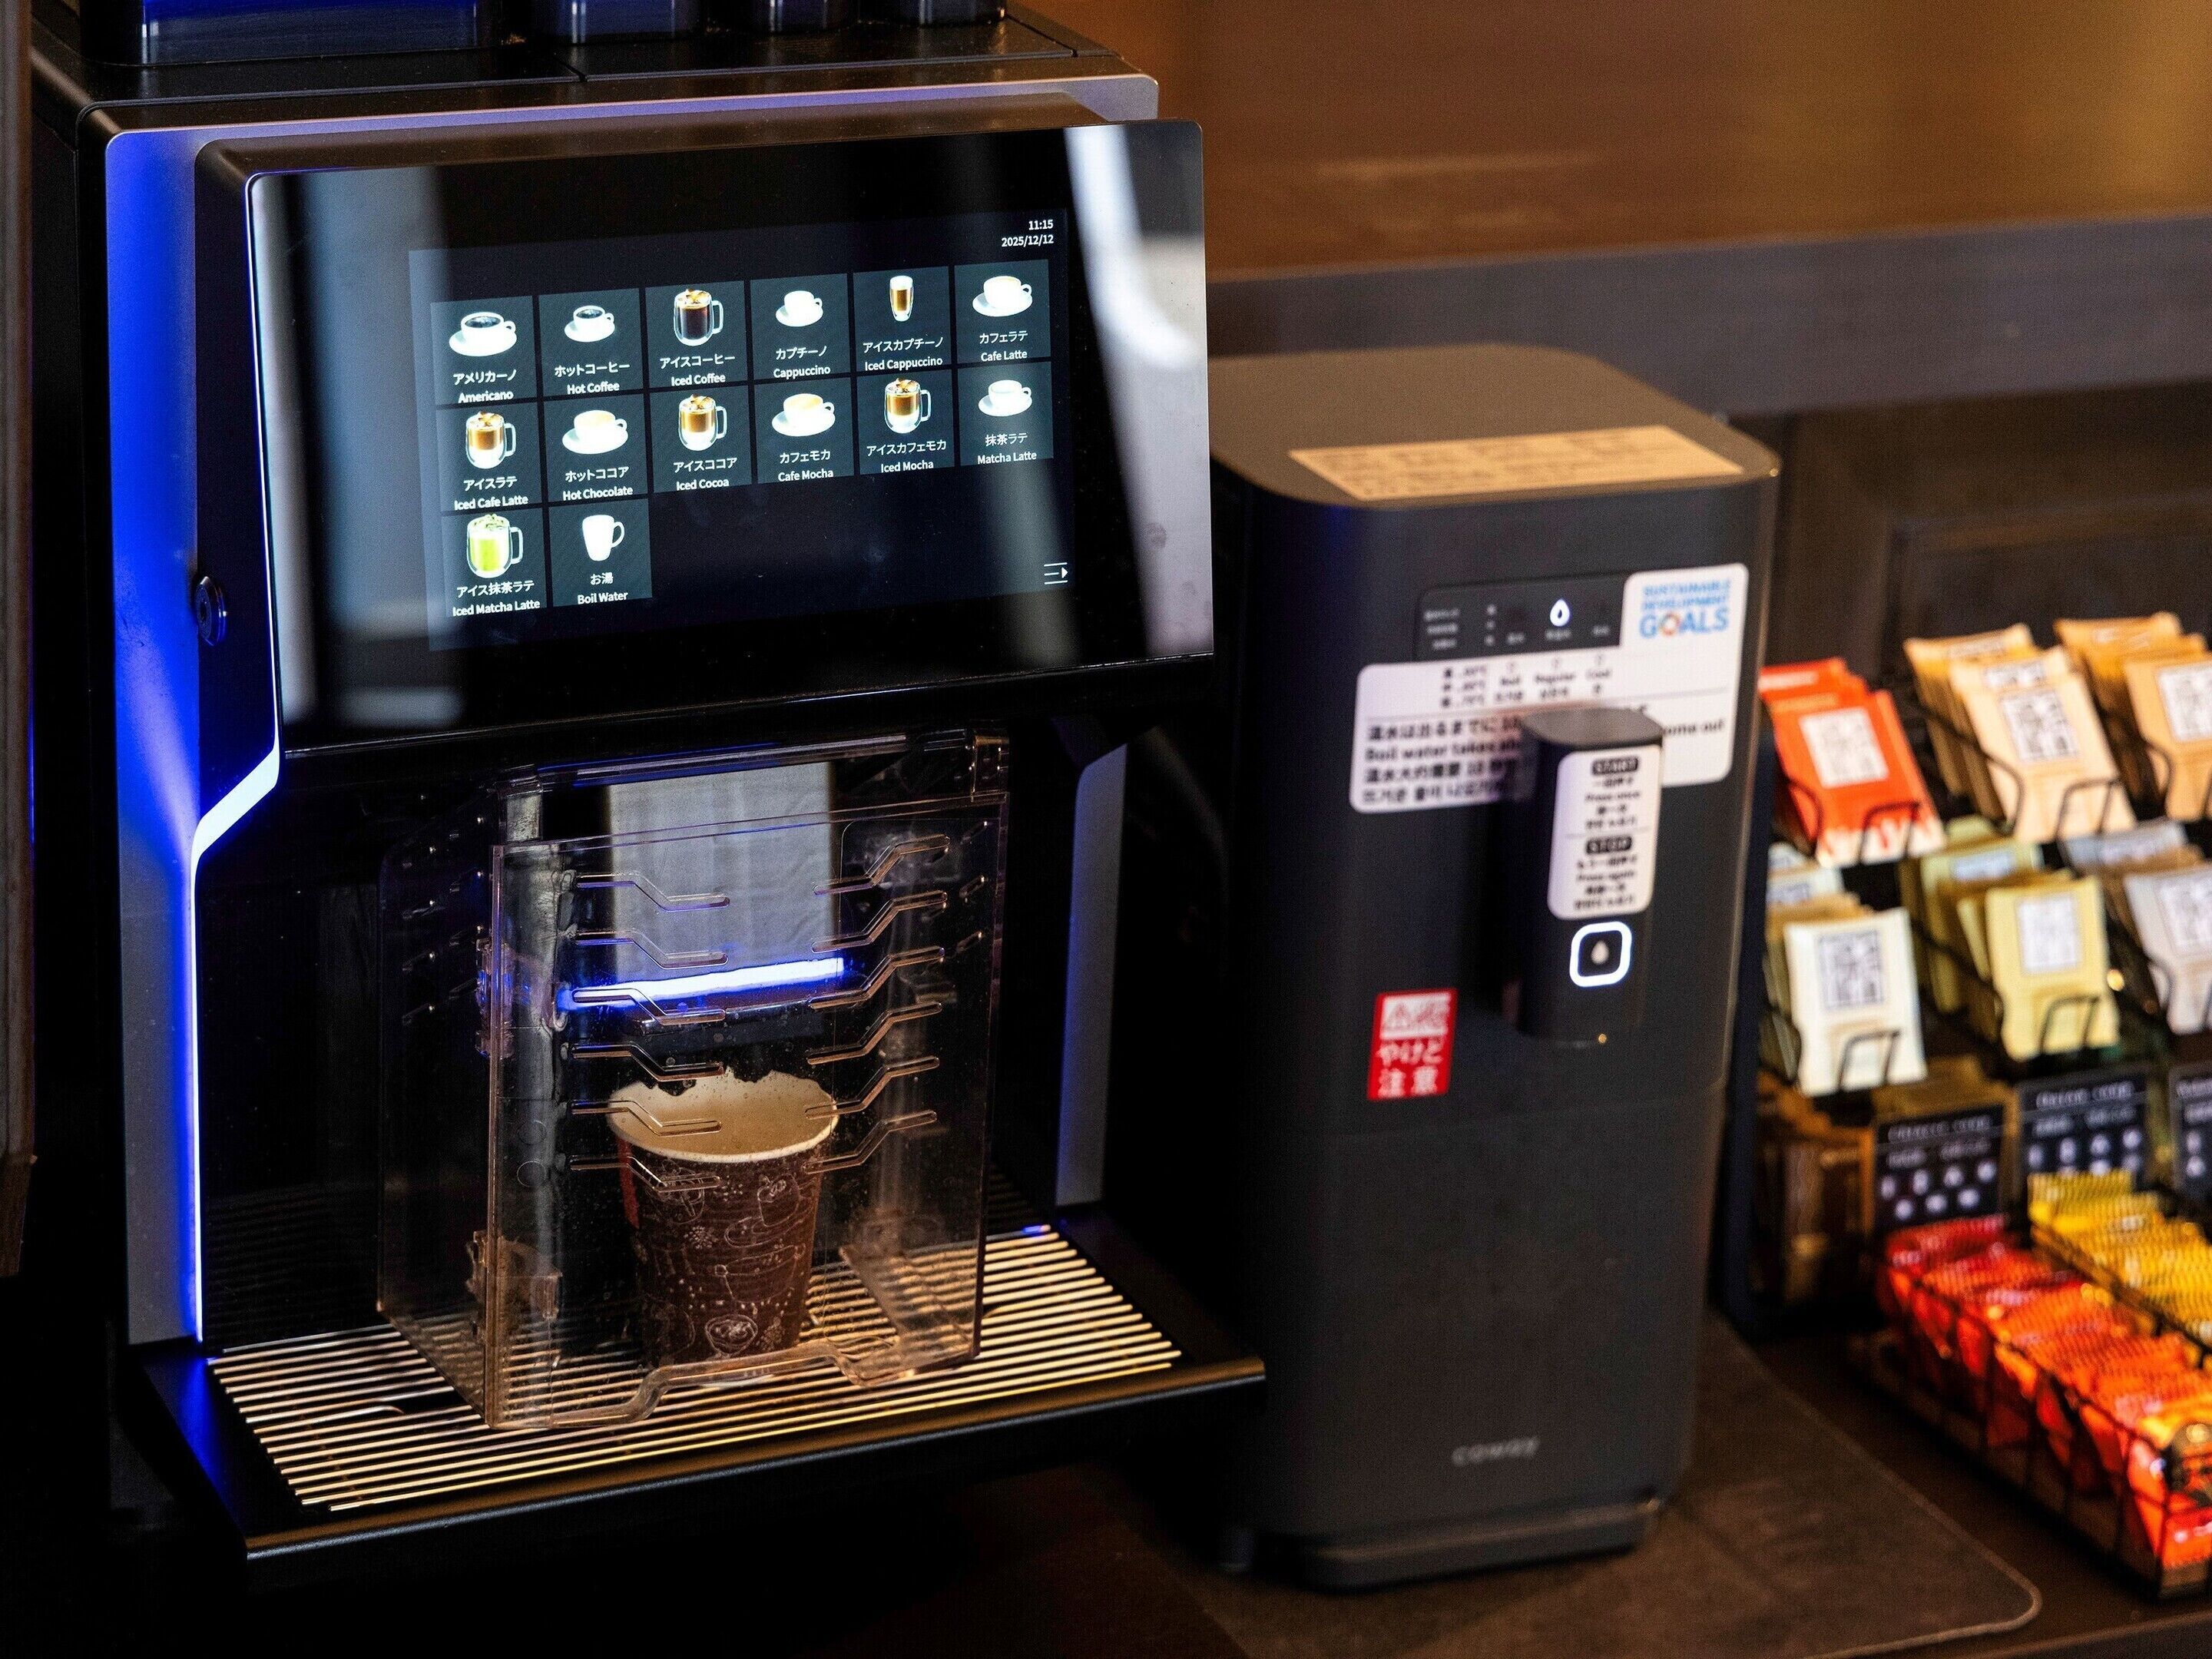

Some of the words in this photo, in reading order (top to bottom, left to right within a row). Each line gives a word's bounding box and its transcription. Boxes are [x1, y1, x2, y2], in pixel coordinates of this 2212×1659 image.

[1028, 220, 1054, 230] 11:15
[1001, 234, 1054, 247] 2025/12/12
[863, 336, 944, 354] アイスカプチーノ
[979, 330, 1028, 345] カフェラテ
[775, 346, 828, 360] カプチーノ
[980, 351, 1002, 363] Cafe
[1002, 349, 1028, 360] Latte
[660, 354, 737, 369] アイスコーヒー
[864, 359, 885, 372] Iced
[886, 356, 943, 372] Cappuccino
[452, 369, 517, 385] アメリカーノ
[554, 362, 631, 378] ホットコーヒー
[773, 364, 831, 381] Cappuccino
[671, 375, 691, 386] Iced
[693, 373, 727, 385] Coffee
[567, 384, 586, 395] Hot
[587, 382, 620, 393] Coffee
[458, 389, 514, 404] Americano
[985, 432, 1028, 446] 抹茶ラテ
[866, 439, 947, 457] アイスカフェモカ
[779, 449, 831, 464] カフェモカ
[977, 451, 1012, 465] Matcha
[1012, 449, 1038, 462] Latte
[674, 458, 737, 474] アイスココア
[880, 462, 900, 474] Iced
[902, 459, 934, 472] Mocha
[565, 467, 630, 483] ホットココア
[777, 472, 800, 482] Cafe
[801, 467, 834, 480] Mocha
[463, 475, 518, 492] アイスラテ
[676, 478, 697, 491] Iced
[698, 477, 730, 489] Cocoa
[563, 490, 581, 501] Hot
[582, 485, 634, 499] Chocolate
[454, 498, 475, 511] Iced
[477, 496, 501, 508] Cafe
[502, 494, 528, 506] Latte
[590, 572, 614, 585] お湯
[456, 580, 535, 598] アイス抹茶ラテ
[578, 593, 597, 605] Boil
[598, 590, 628, 603] Water
[452, 604, 474, 617] Iced
[475, 601, 512, 614] Matcha
[514, 599, 541, 611] Latte
[1639, 608, 1729, 638] GOALS
